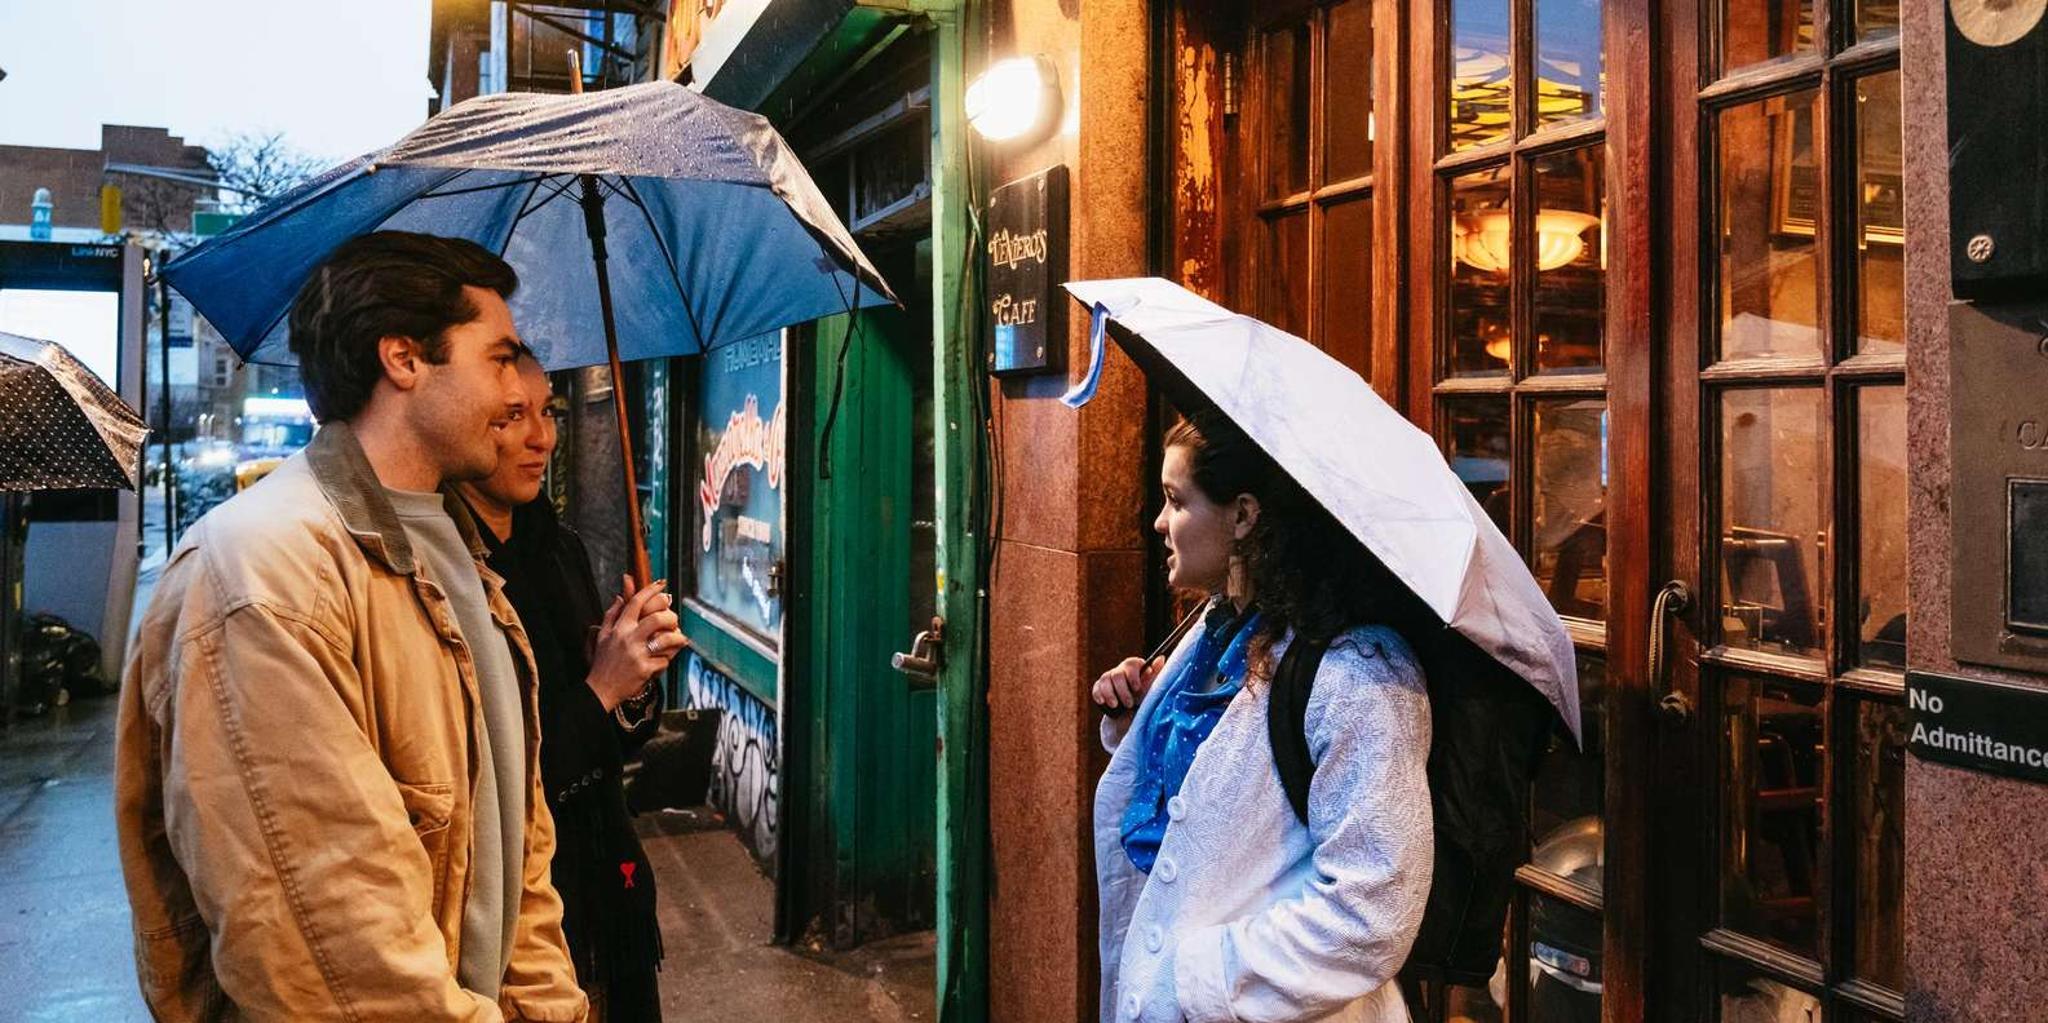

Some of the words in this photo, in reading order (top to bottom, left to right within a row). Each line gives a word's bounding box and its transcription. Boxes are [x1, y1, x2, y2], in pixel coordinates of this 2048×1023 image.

[988, 227, 1048, 270] VENIERO'S
[992, 293, 1036, 328] CAFE
[1908, 687, 1943, 714] No
